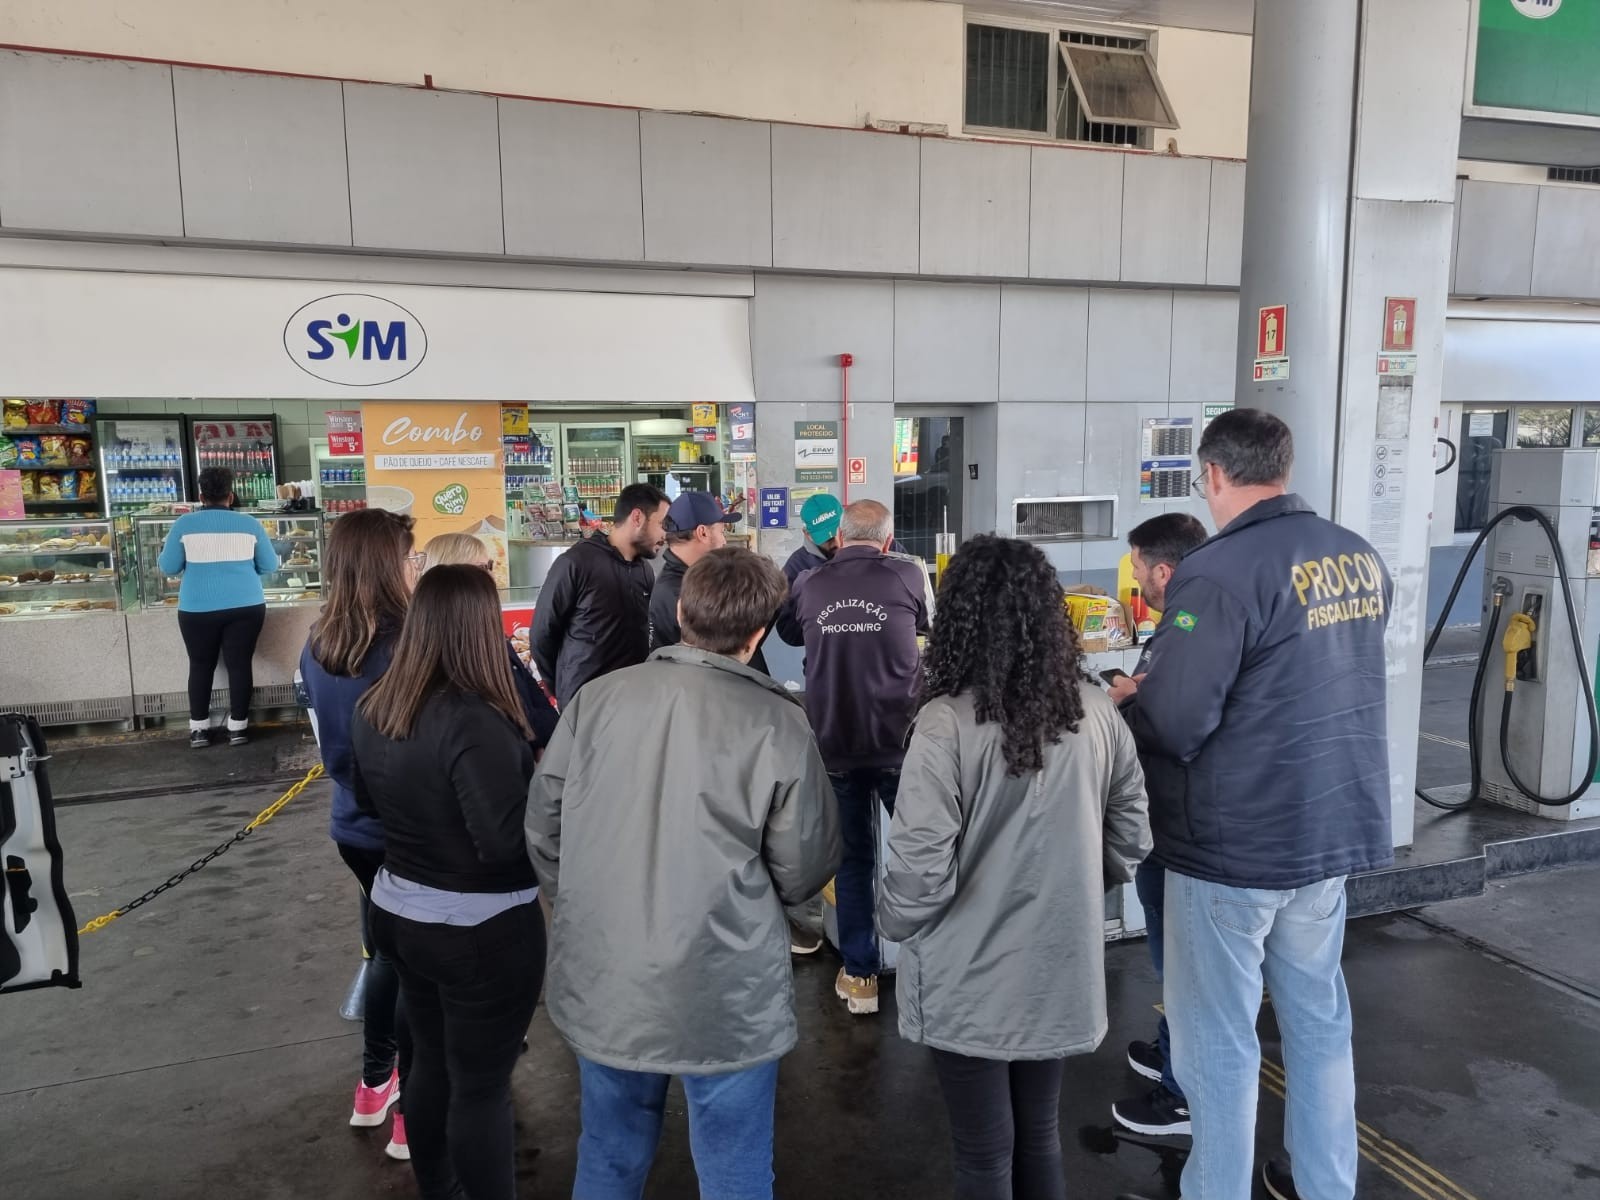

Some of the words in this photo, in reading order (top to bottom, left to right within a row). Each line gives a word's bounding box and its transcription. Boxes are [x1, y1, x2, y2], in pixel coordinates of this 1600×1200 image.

[1395, 320, 1405, 331] 17
[306, 313, 407, 361] SIM
[1266, 329, 1276, 341] 17
[1206, 407, 1235, 416] SEGUR
[382, 411, 483, 446] Combo
[383, 456, 398, 467] PÃO
[400, 457, 409, 467] DE
[816, 598, 888, 625] FISCALIZAÇÃO
[821, 622, 882, 635] PROCON/RG
